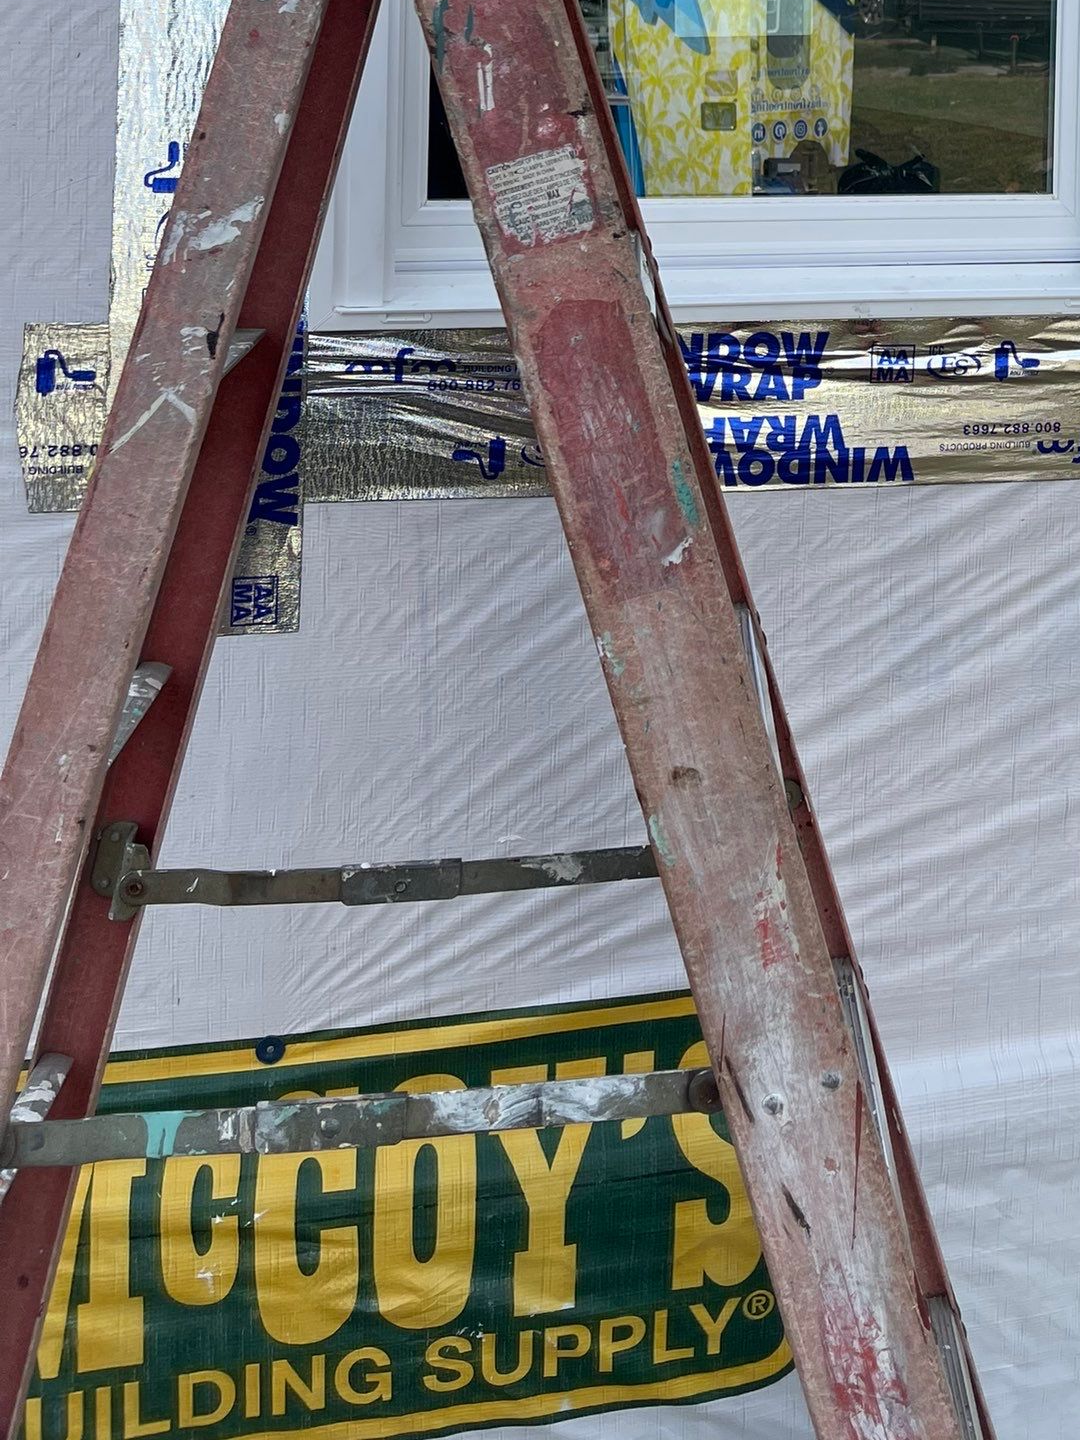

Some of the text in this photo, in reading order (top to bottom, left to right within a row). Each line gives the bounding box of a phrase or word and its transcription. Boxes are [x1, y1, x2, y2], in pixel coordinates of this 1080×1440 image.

[345, 347, 512, 384] mfm BUILDING
[878, 349, 910, 366] AA
[876, 366, 909, 381] MA
[963, 422, 1061, 436] 800.882.7663
[939, 442, 987, 452] PRODUCTS
[990, 440, 1031, 450] BUILDING
[28, 465, 84, 475] BUILDING
[233, 583, 247, 622] MA
[253, 584, 274, 620] AA
[25, 1346, 393, 1440] UILDING
